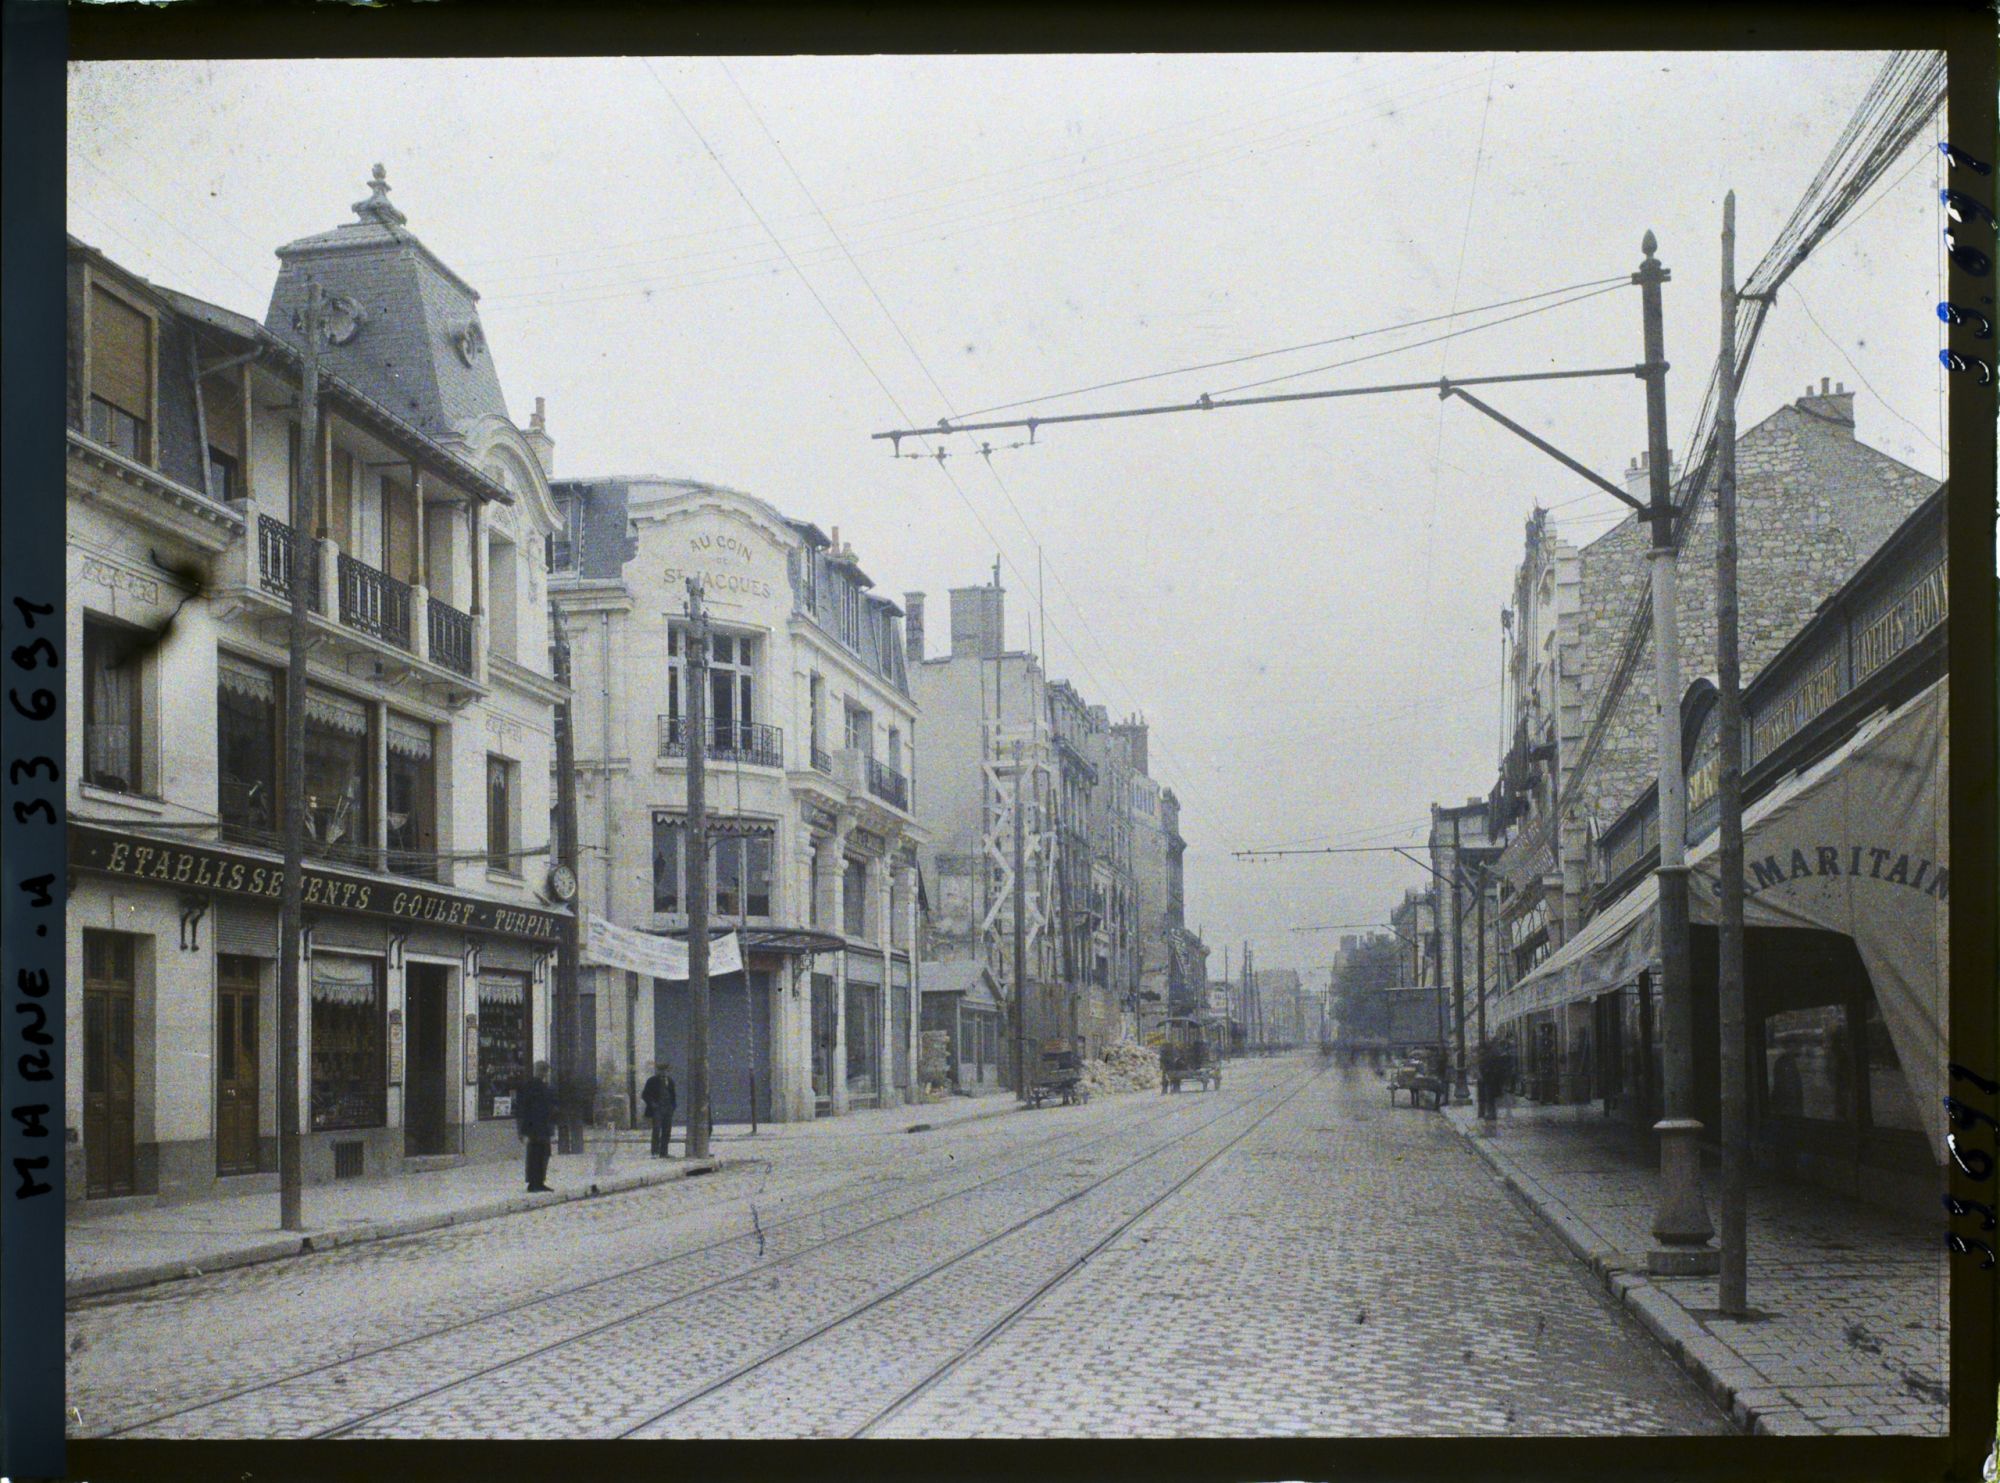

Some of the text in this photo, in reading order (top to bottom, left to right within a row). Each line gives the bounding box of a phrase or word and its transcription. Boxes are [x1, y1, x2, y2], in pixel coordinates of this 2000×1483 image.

[690, 535, 753, 562] AU COIN
[107, 841, 372, 910] ETABLISSEENTS
[393, 891, 475, 926] GOULET
[494, 908, 555, 938] TURPIN
[11, 967, 54, 1201] MARNE
